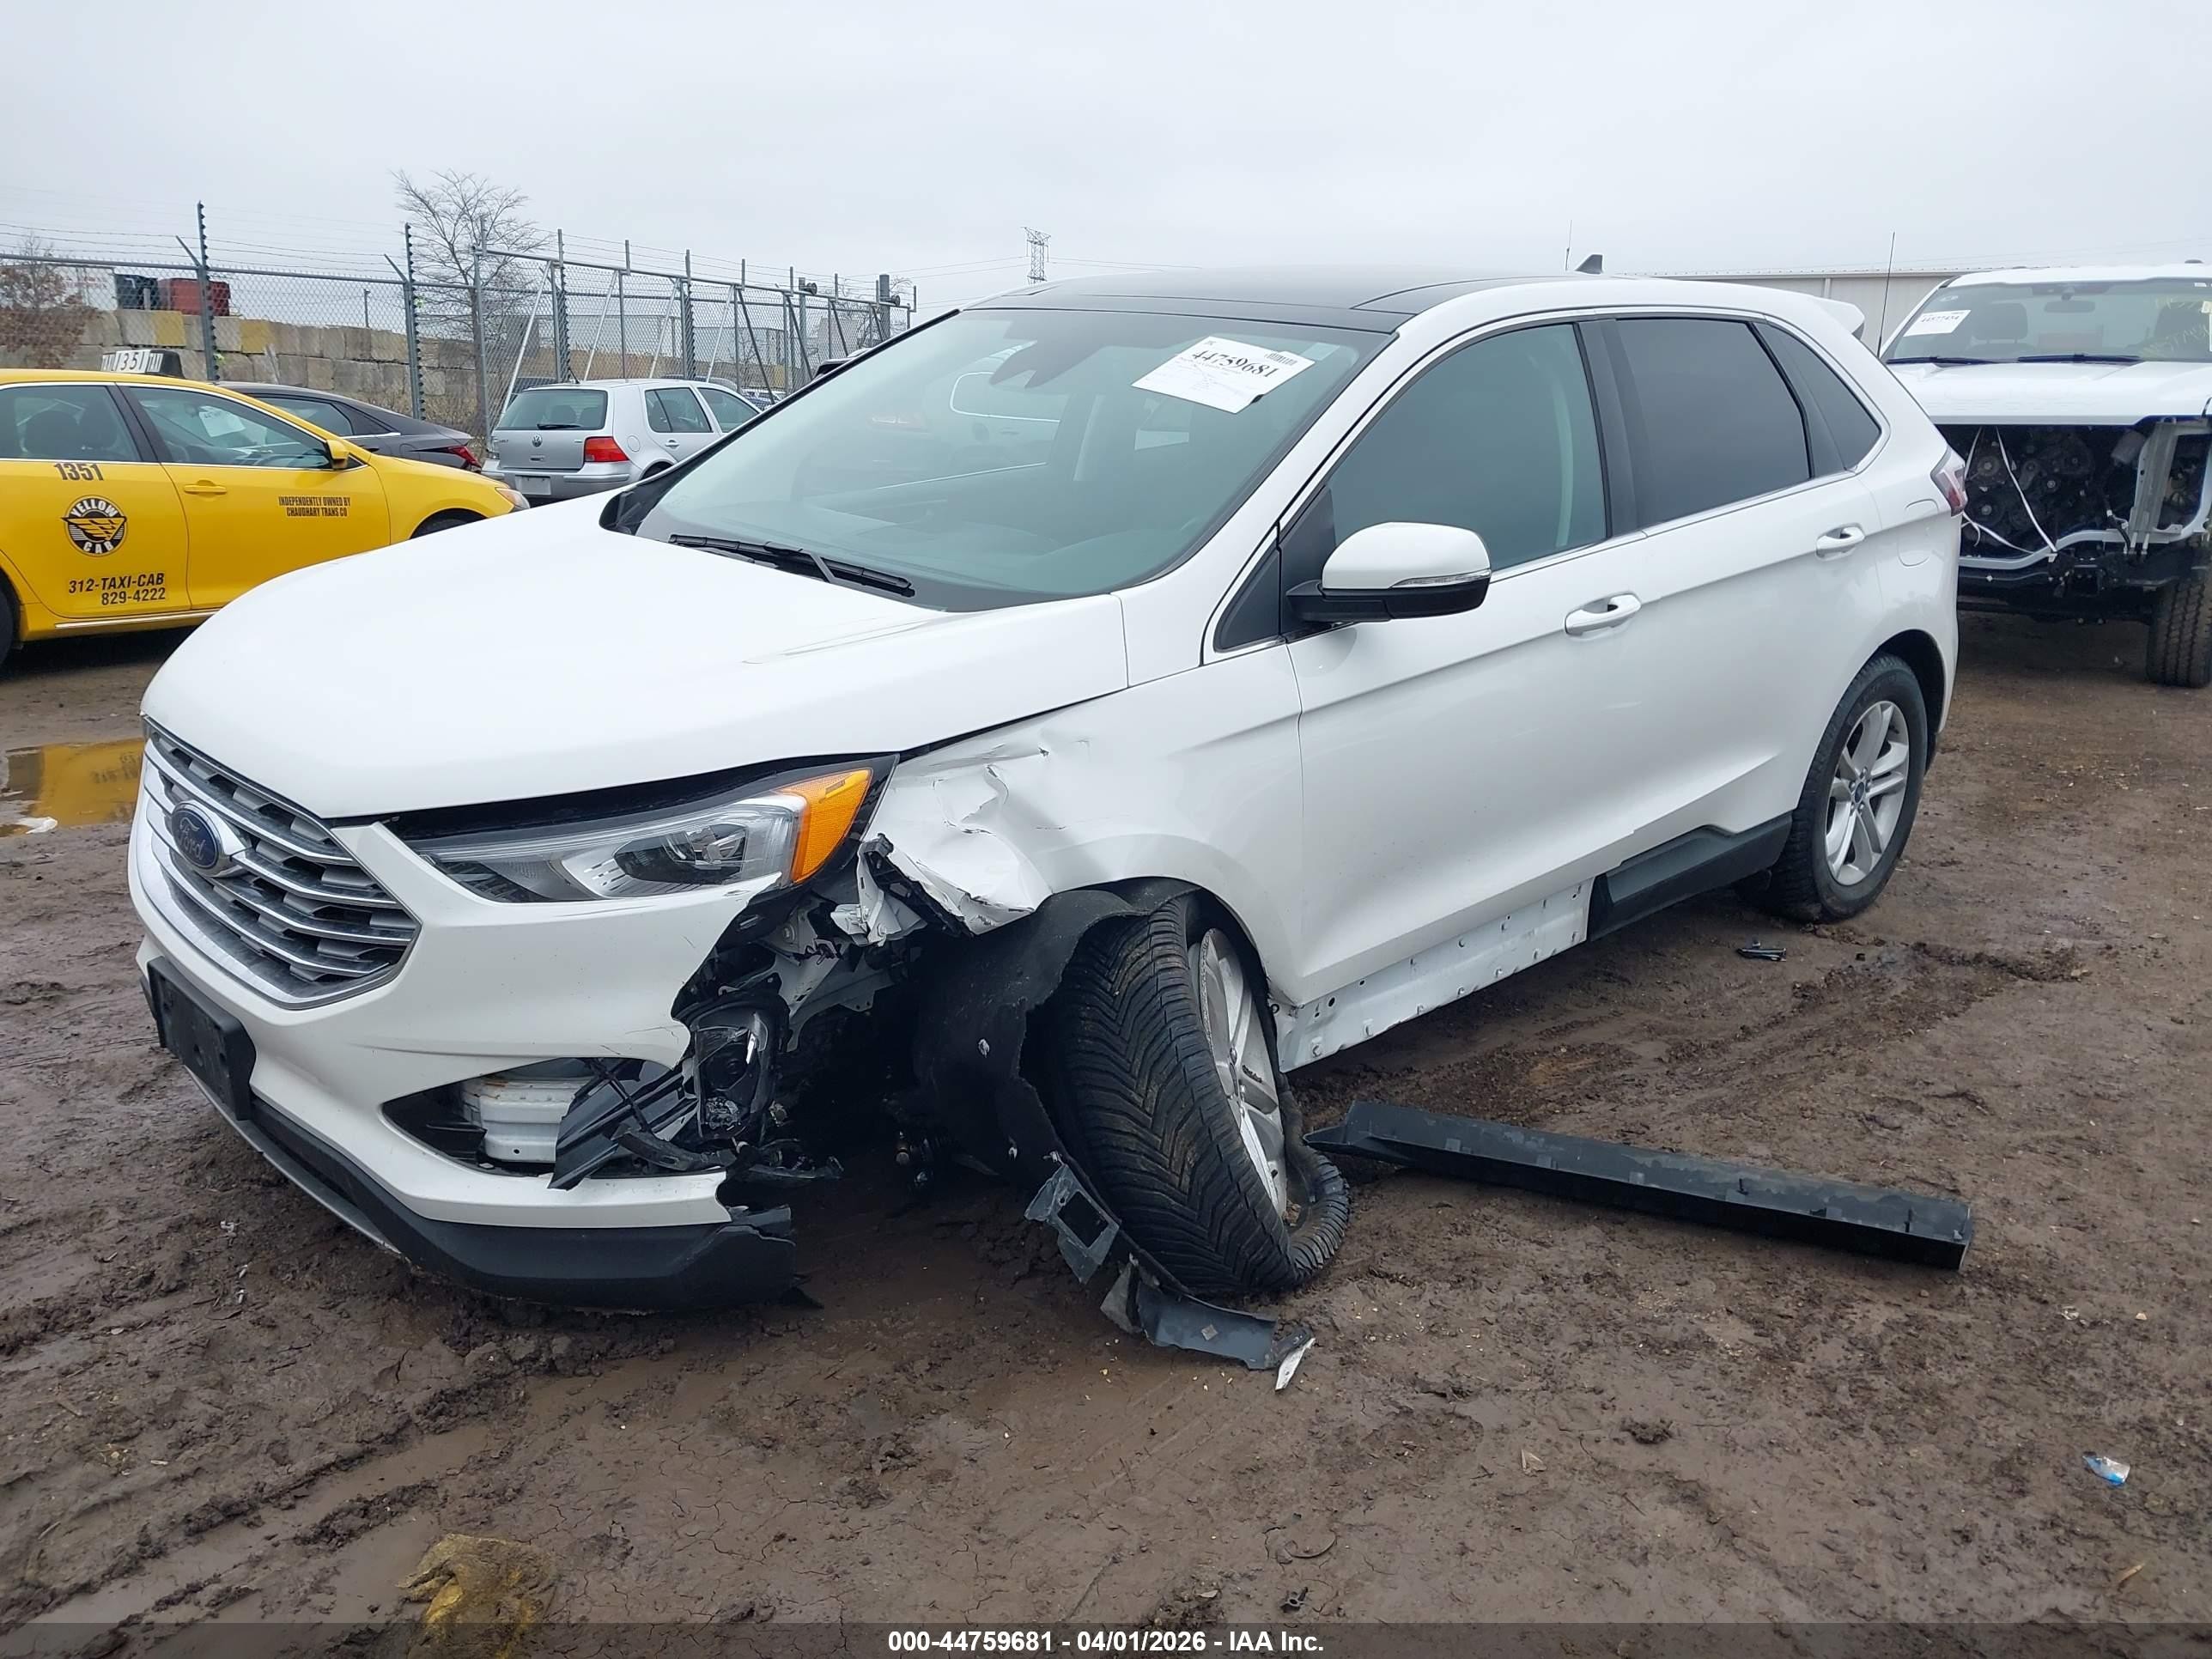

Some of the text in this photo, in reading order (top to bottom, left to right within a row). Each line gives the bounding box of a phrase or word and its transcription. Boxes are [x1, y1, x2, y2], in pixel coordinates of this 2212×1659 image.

[115, 352, 146, 371] 1351
[1192, 349, 1279, 378] 44759681
[54, 463, 104, 481] 1351
[70, 498, 118, 518] YELLOW
[278, 496, 351, 507] INDEPENDENTLY OWNED BY
[321, 507, 338, 517] TRANS
[339, 507, 348, 517] CO
[82, 540, 114, 555] CAB
[69, 573, 165, 593] 312-TAXI-CAB
[101, 587, 166, 605] 829-4222
[178, 817, 206, 860] Ford
